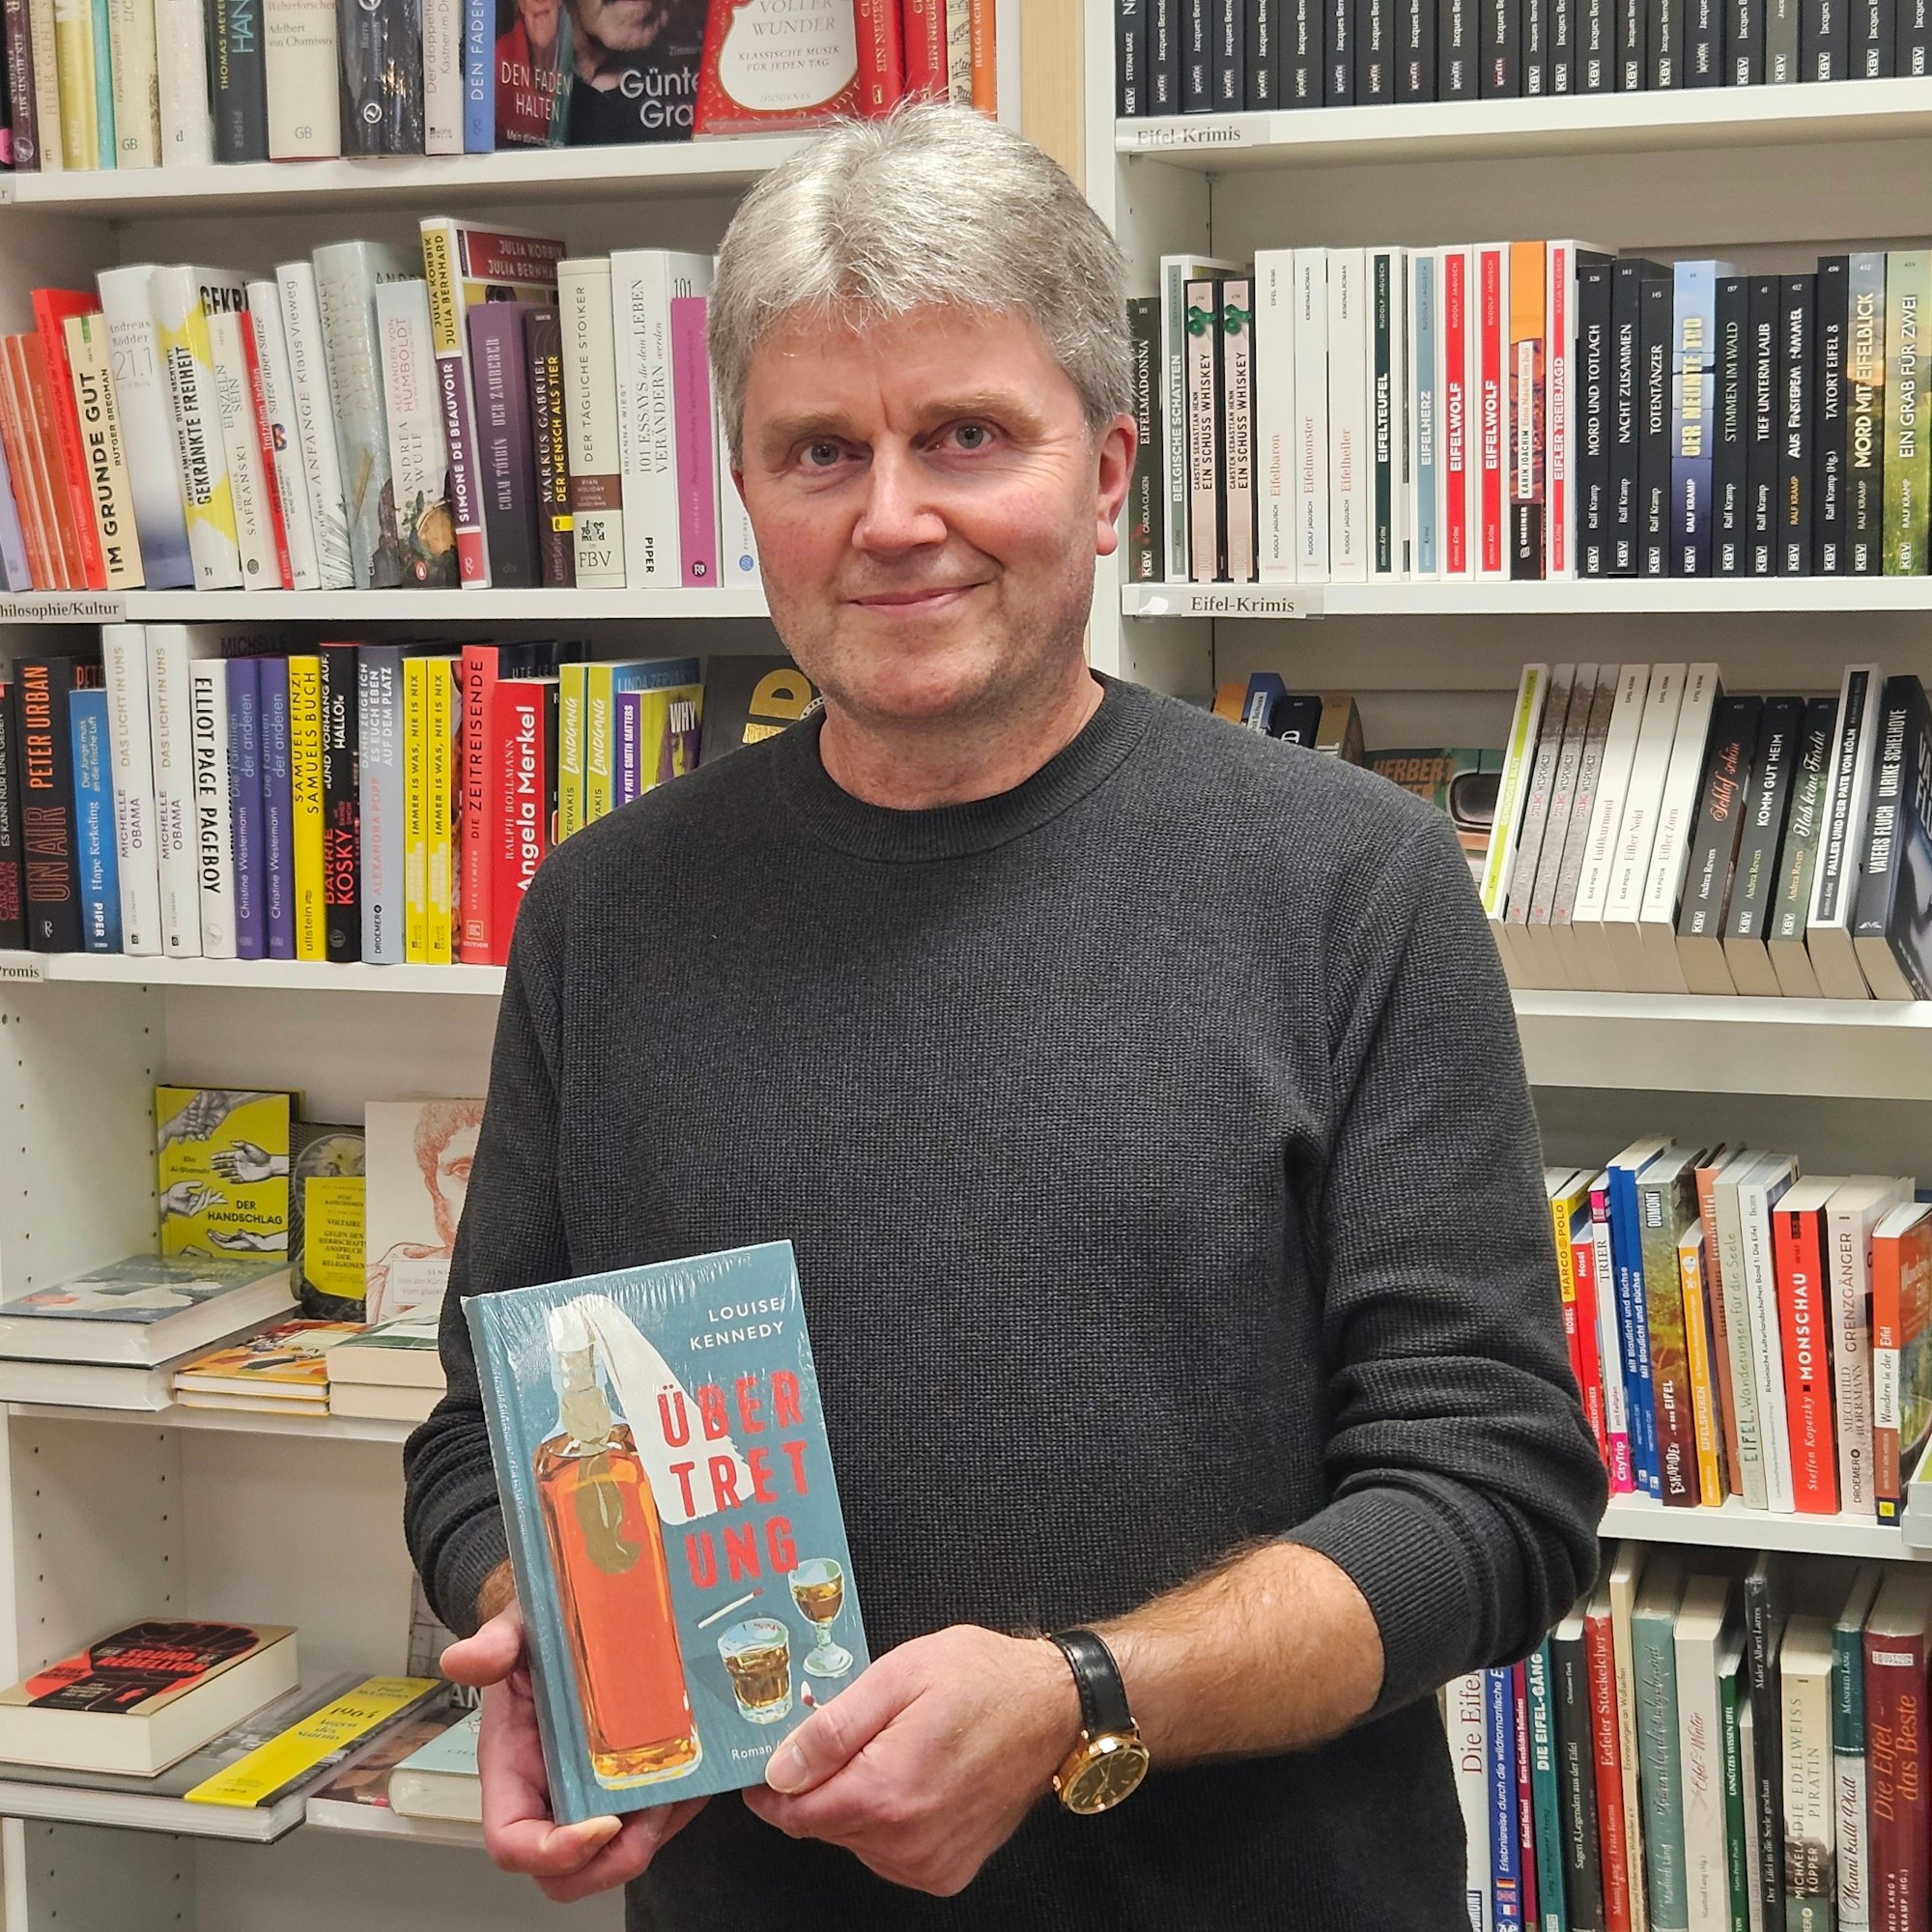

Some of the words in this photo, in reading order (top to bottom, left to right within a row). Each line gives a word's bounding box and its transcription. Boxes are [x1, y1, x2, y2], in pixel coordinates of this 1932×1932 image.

[753, 18, 836, 38] WUNDER
[738, 49, 803, 61] KLASSISCHE
[806, 45, 839, 55] MUSIK
[747, 61, 767, 72] FÜR
[771, 60, 805, 71] JEDEN
[809, 59, 830, 68] TAG
[1659, 58, 1670, 86] KBV
[501, 61, 530, 88] DEN
[535, 69, 574, 95] FADEN
[1125, 87, 1136, 115] KBV
[516, 94, 559, 122] HALTEN
[639, 99, 694, 128] Gra
[1136, 126, 1241, 147] Eifel-Krimis
[423, 238, 439, 285] KORBIK
[435, 235, 452, 303] BERNHARD
[287, 281, 299, 338] Vieweg
[433, 287, 442, 327] JULIA
[444, 307, 456, 345] JULIA
[576, 286, 588, 349] STOIKER
[632, 278, 647, 335] LEBEN
[1588, 325, 1601, 383] TOTLACH
[1757, 323, 1771, 360] LAUB
[1856, 293, 1874, 381] EIFELBLICK
[176, 346, 201, 416] FREIHEIT
[297, 339, 308, 384] Klaus
[396, 317, 414, 412] HUMBOLDT
[548, 355, 559, 384] TIER
[1200, 354, 1211, 412] WHISKEY
[1618, 324, 1632, 397] ZUSAMMEN
[79, 372, 101, 423] GUT
[101, 368, 117, 422] BREGMAN
[441, 363, 462, 437] BEAUVOIR
[533, 356, 548, 429] GABRIEL
[550, 386, 562, 413] ALS
[580, 354, 591, 431] TÄGLICHE
[1140, 340, 1151, 445] EIFELMADONNA
[1170, 355, 1182, 426] SCHATTEN
[1552, 356, 1564, 435] TREIBJAGD
[1587, 385, 1601, 413] UND
[1650, 344, 1663, 436] TOTENTÄNZER
[1757, 362, 1771, 412] UNTERM
[1855, 383, 1871, 413] MIT
[635, 382, 650, 447] ESSAYS
[651, 365, 668, 473] VERÄNDERN
[1377, 372, 1389, 464] EIFELTEUFEL
[1421, 389, 1432, 467] EIFELHERZ
[1449, 383, 1462, 472] EIFELWOLF
[1587, 415, 1601, 456] MORD
[1618, 400, 1632, 443] NACHT
[1757, 413, 1770, 442] TIEF
[104, 424, 122, 466] RUTGER
[188, 417, 213, 504] GEKRÄNKTE
[452, 439, 464, 461] DE
[553, 416, 565, 475] MENSCH
[583, 433, 593, 463] DER
[1201, 413, 1212, 465] SCHUSS
[1303, 416, 1314, 495] Eifelmonster
[1340, 428, 1351, 493] Eifelheiler
[1553, 437, 1564, 481] EIFLER
[1854, 415, 1872, 469] MORD
[90, 431, 119, 538] GRUNDE
[537, 432, 554, 503] MARKUS
[1171, 427, 1183, 503] BELGISCHE
[1202, 468, 1212, 491] EIN
[241, 444, 256, 536] SAFRANSKI
[454, 466, 470, 523] SIMONE
[555, 479, 567, 503] DER
[108, 546, 123, 574] IM
[579, 551, 611, 567] FBV
[644, 536, 654, 574] PIPER
[1141, 551, 1152, 578] KBV
[0, 601, 120, 620] hilosophie/Kultur
[1190, 595, 1295, 613] Eifel-Krimis
[114, 646, 126, 676] UNS
[410, 674, 418, 694] NIX
[23, 665, 52, 729] URBAN
[116, 678, 127, 696] IN
[291, 672, 300, 724] FINZI
[304, 672, 316, 722] BUCH
[382, 667, 392, 705] PLATZ
[412, 697, 419, 714] IS
[118, 697, 129, 739] LICHT
[194, 677, 215, 742] ELLIOT
[242, 693, 254, 751] anderen
[383, 707, 393, 736] DEM
[669, 701, 696, 733] WHY
[120, 742, 131, 768] DAS
[383, 739, 393, 767] AUF
[469, 661, 484, 811] ZEITREISENDE
[516, 705, 535, 794] Merkel
[1768, 732, 1783, 763] HEIM
[1884, 709, 1907, 761] SCHELHOVE
[30, 734, 53, 789] PETER
[198, 748, 216, 796] PAGE
[245, 753, 255, 778] der
[293, 738, 304, 803] SAMUEL
[304, 731, 319, 815] SAMUELS
[412, 744, 420, 775] WAS,
[1762, 760, 1776, 788] GUT
[1878, 764, 1900, 797] ULRIKE
[412, 777, 419, 792] IS
[117, 788, 129, 859] MICHELLE
[130, 797, 143, 850] OBAMA
[412, 795, 420, 836] IMMER
[471, 817, 480, 839] DIE
[1756, 789, 1771, 828] KOMM
[1874, 806, 1894, 836] FLUCH
[23, 806, 68, 860] AIR
[87, 802, 101, 862] Kerkeling
[201, 807, 221, 894] PAGEBOY
[238, 806, 248, 869] Westermann
[515, 801, 540, 892] Angela
[92, 862, 103, 892] Hape
[336, 829, 355, 905] KOSKY
[1868, 838, 1891, 873] VATERS
[240, 870, 252, 920] Christine
[0, 964, 41, 979] romis
[207, 1212, 283, 1225] HANDSCHLAG
[236, 1200, 257, 1210] DER
[1556, 1204, 1567, 1241] POLO
[1559, 1250, 1573, 1295] MARCO
[1598, 1238, 1610, 1283] TRIER
[707, 1296, 781, 1324] LOUISE
[1839, 1233, 1858, 1353] GRENZGÄNGER
[689, 1319, 785, 1352] KENNEDY
[1792, 1271, 1814, 1381] MONSCHAU
[656, 1370, 805, 1449] ÜBER
[669, 1441, 810, 1520] TRET
[683, 1517, 800, 1591] UNG
[1530, 1652, 1548, 1741] EIFEL-GÄNG
[1597, 1634, 1612, 1718] Stöckelcher
[1599, 1720, 1615, 1767] Eefeler
[1870, 1724, 1892, 1772] Eifel
[1898, 1694, 1918, 1756] Beste
[730, 1743, 774, 1760] Roman
[1462, 1733, 1483, 1775] Die
[1536, 1743, 1549, 1772] DIE
[1874, 1776, 1894, 1821] Die
[1899, 1763, 1918, 1802] das
